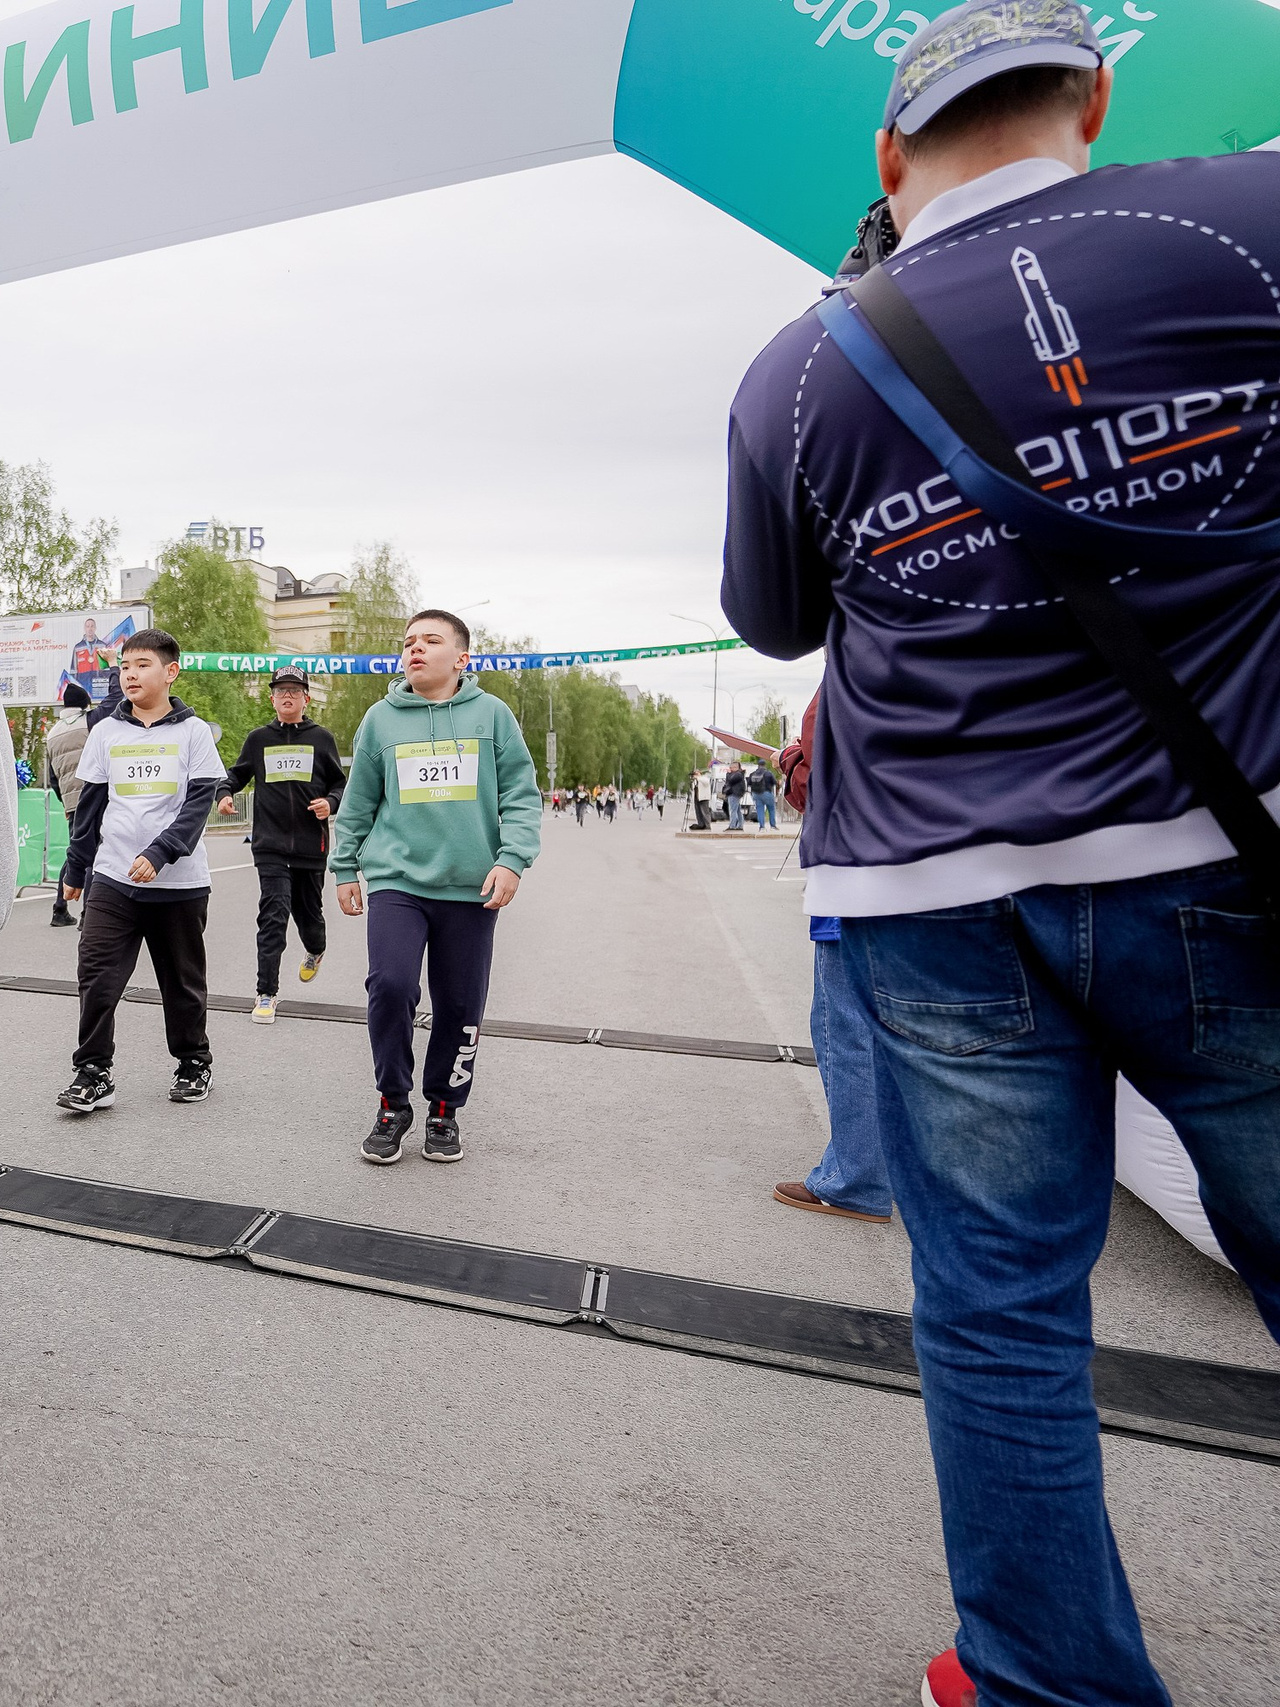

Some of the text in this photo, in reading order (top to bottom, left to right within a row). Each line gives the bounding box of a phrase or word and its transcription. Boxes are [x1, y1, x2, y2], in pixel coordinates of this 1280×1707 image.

[849, 379, 1266, 548] КОСОПОРТ
[1065, 454, 1223, 514] РЯДОМ
[212, 526, 265, 553] ВТБ
[217, 656, 278, 672] СТАРТ
[291, 657, 355, 673] СТАРТ
[127, 764, 161, 778] 3199
[276, 760, 301, 769] 3172
[418, 765, 459, 782] 3211
[428, 788, 452, 798] 700м
[448, 1025, 478, 1088] FILA
